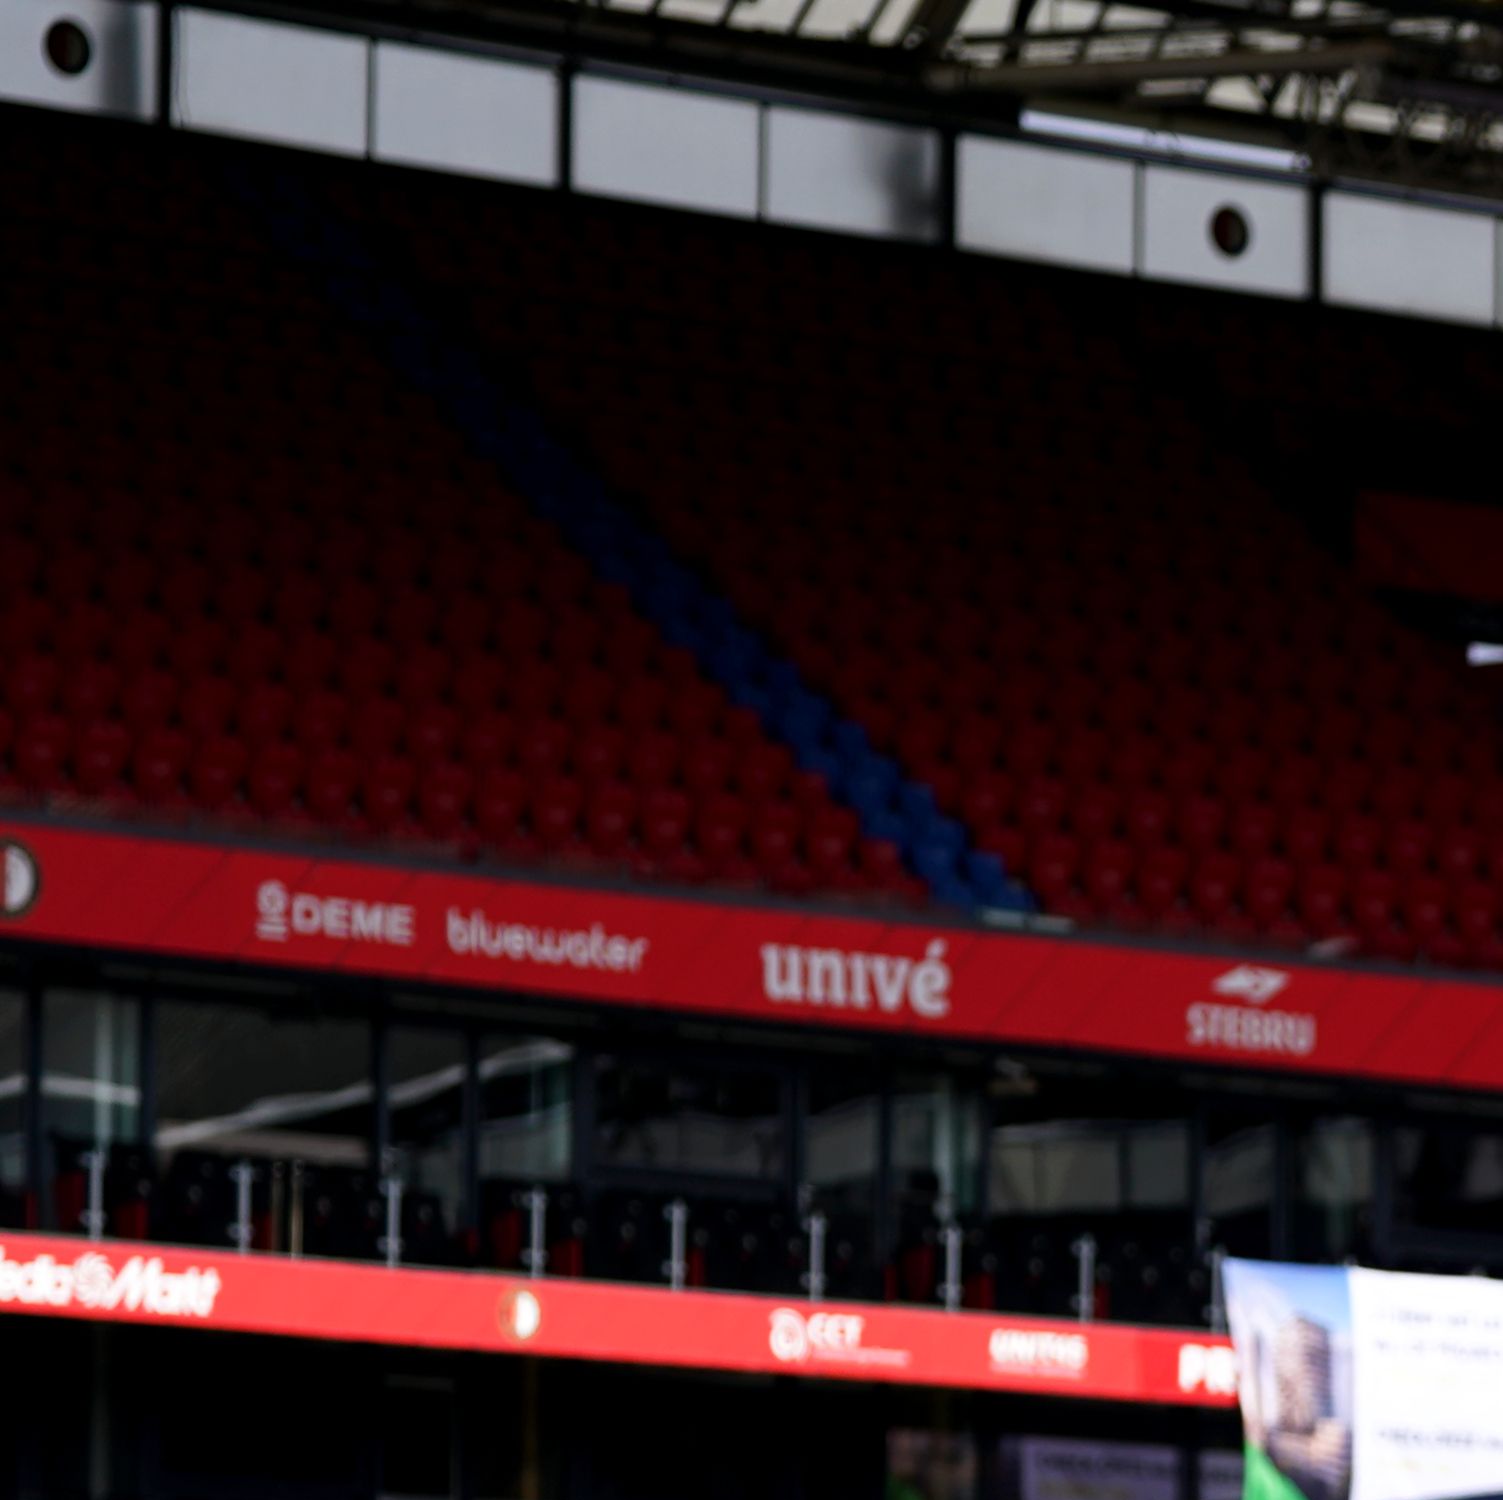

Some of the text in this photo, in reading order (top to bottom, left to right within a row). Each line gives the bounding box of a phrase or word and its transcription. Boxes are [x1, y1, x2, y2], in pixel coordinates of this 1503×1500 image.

[292, 893, 414, 946] DEME
[446, 906, 650, 973] bluewater
[761, 938, 952, 1019] univé
[1186, 1002, 1316, 1055] STEBRU
